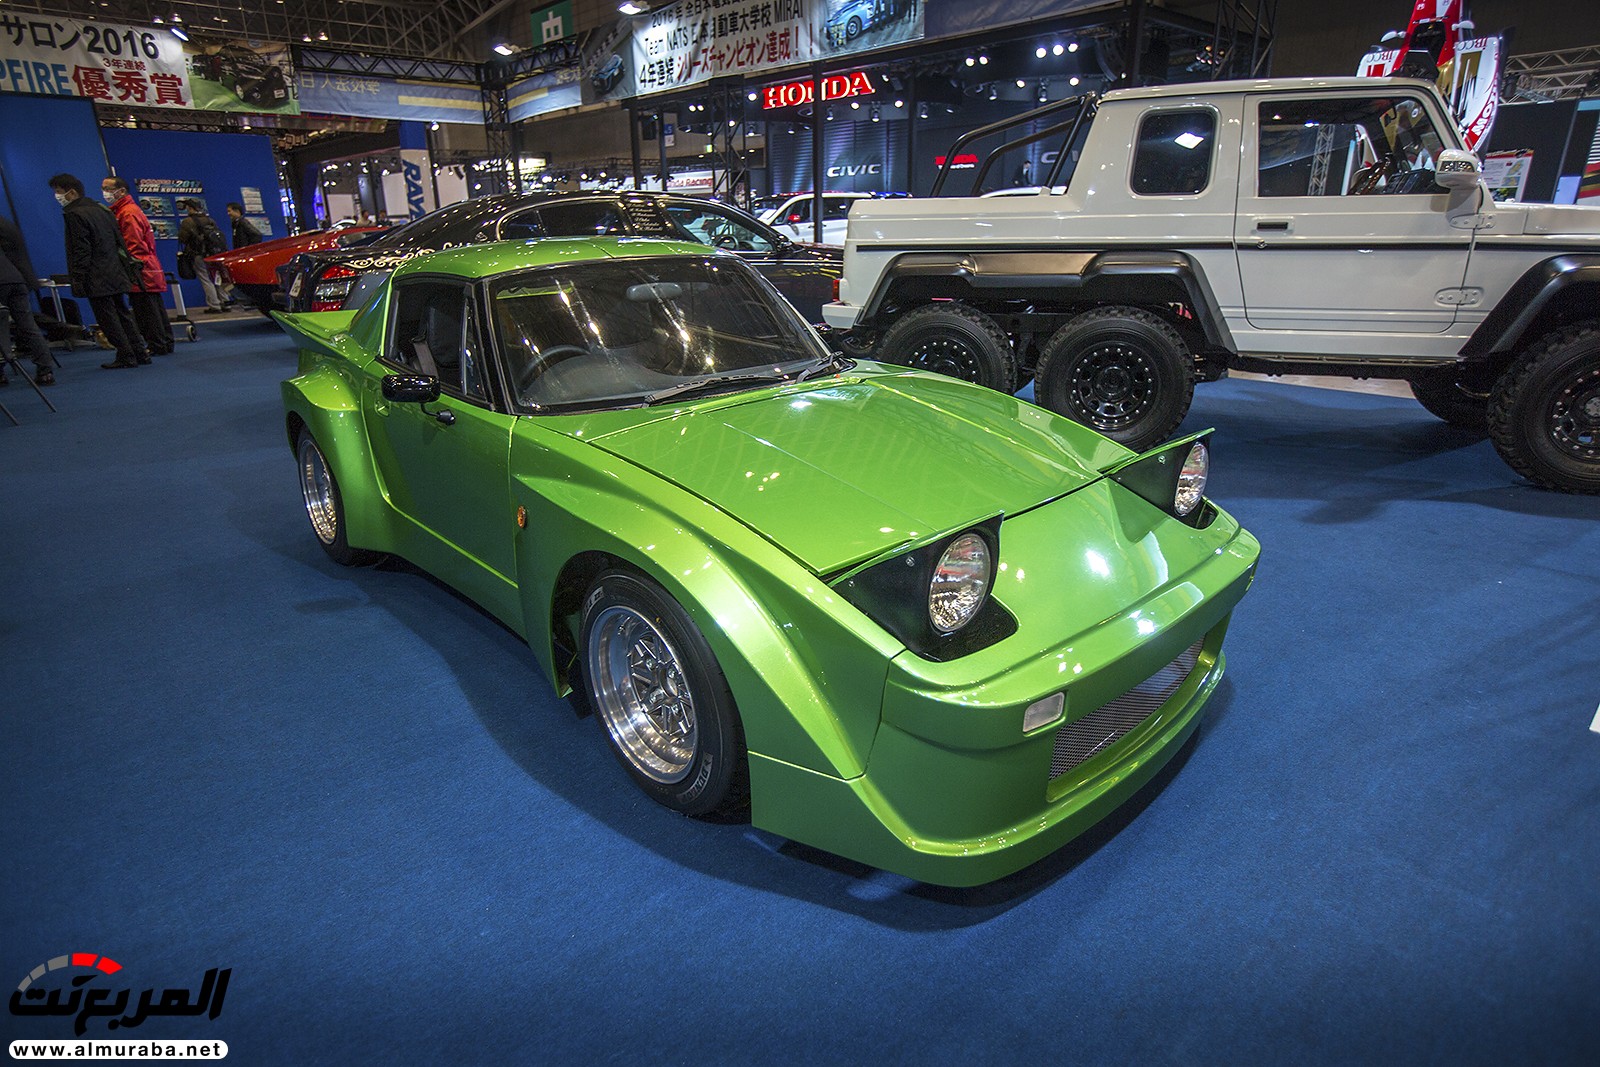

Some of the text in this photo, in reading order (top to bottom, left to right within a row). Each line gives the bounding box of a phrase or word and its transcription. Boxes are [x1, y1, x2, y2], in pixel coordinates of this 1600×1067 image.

[666, 27, 688, 51] NATS
[774, 0, 803, 24] MIRAI
[103, 57, 147, 72] 3年連続
[72, 64, 188, 106] 優秀賞
[762, 72, 876, 109] HONDA
[826, 162, 882, 179] CIVIC
